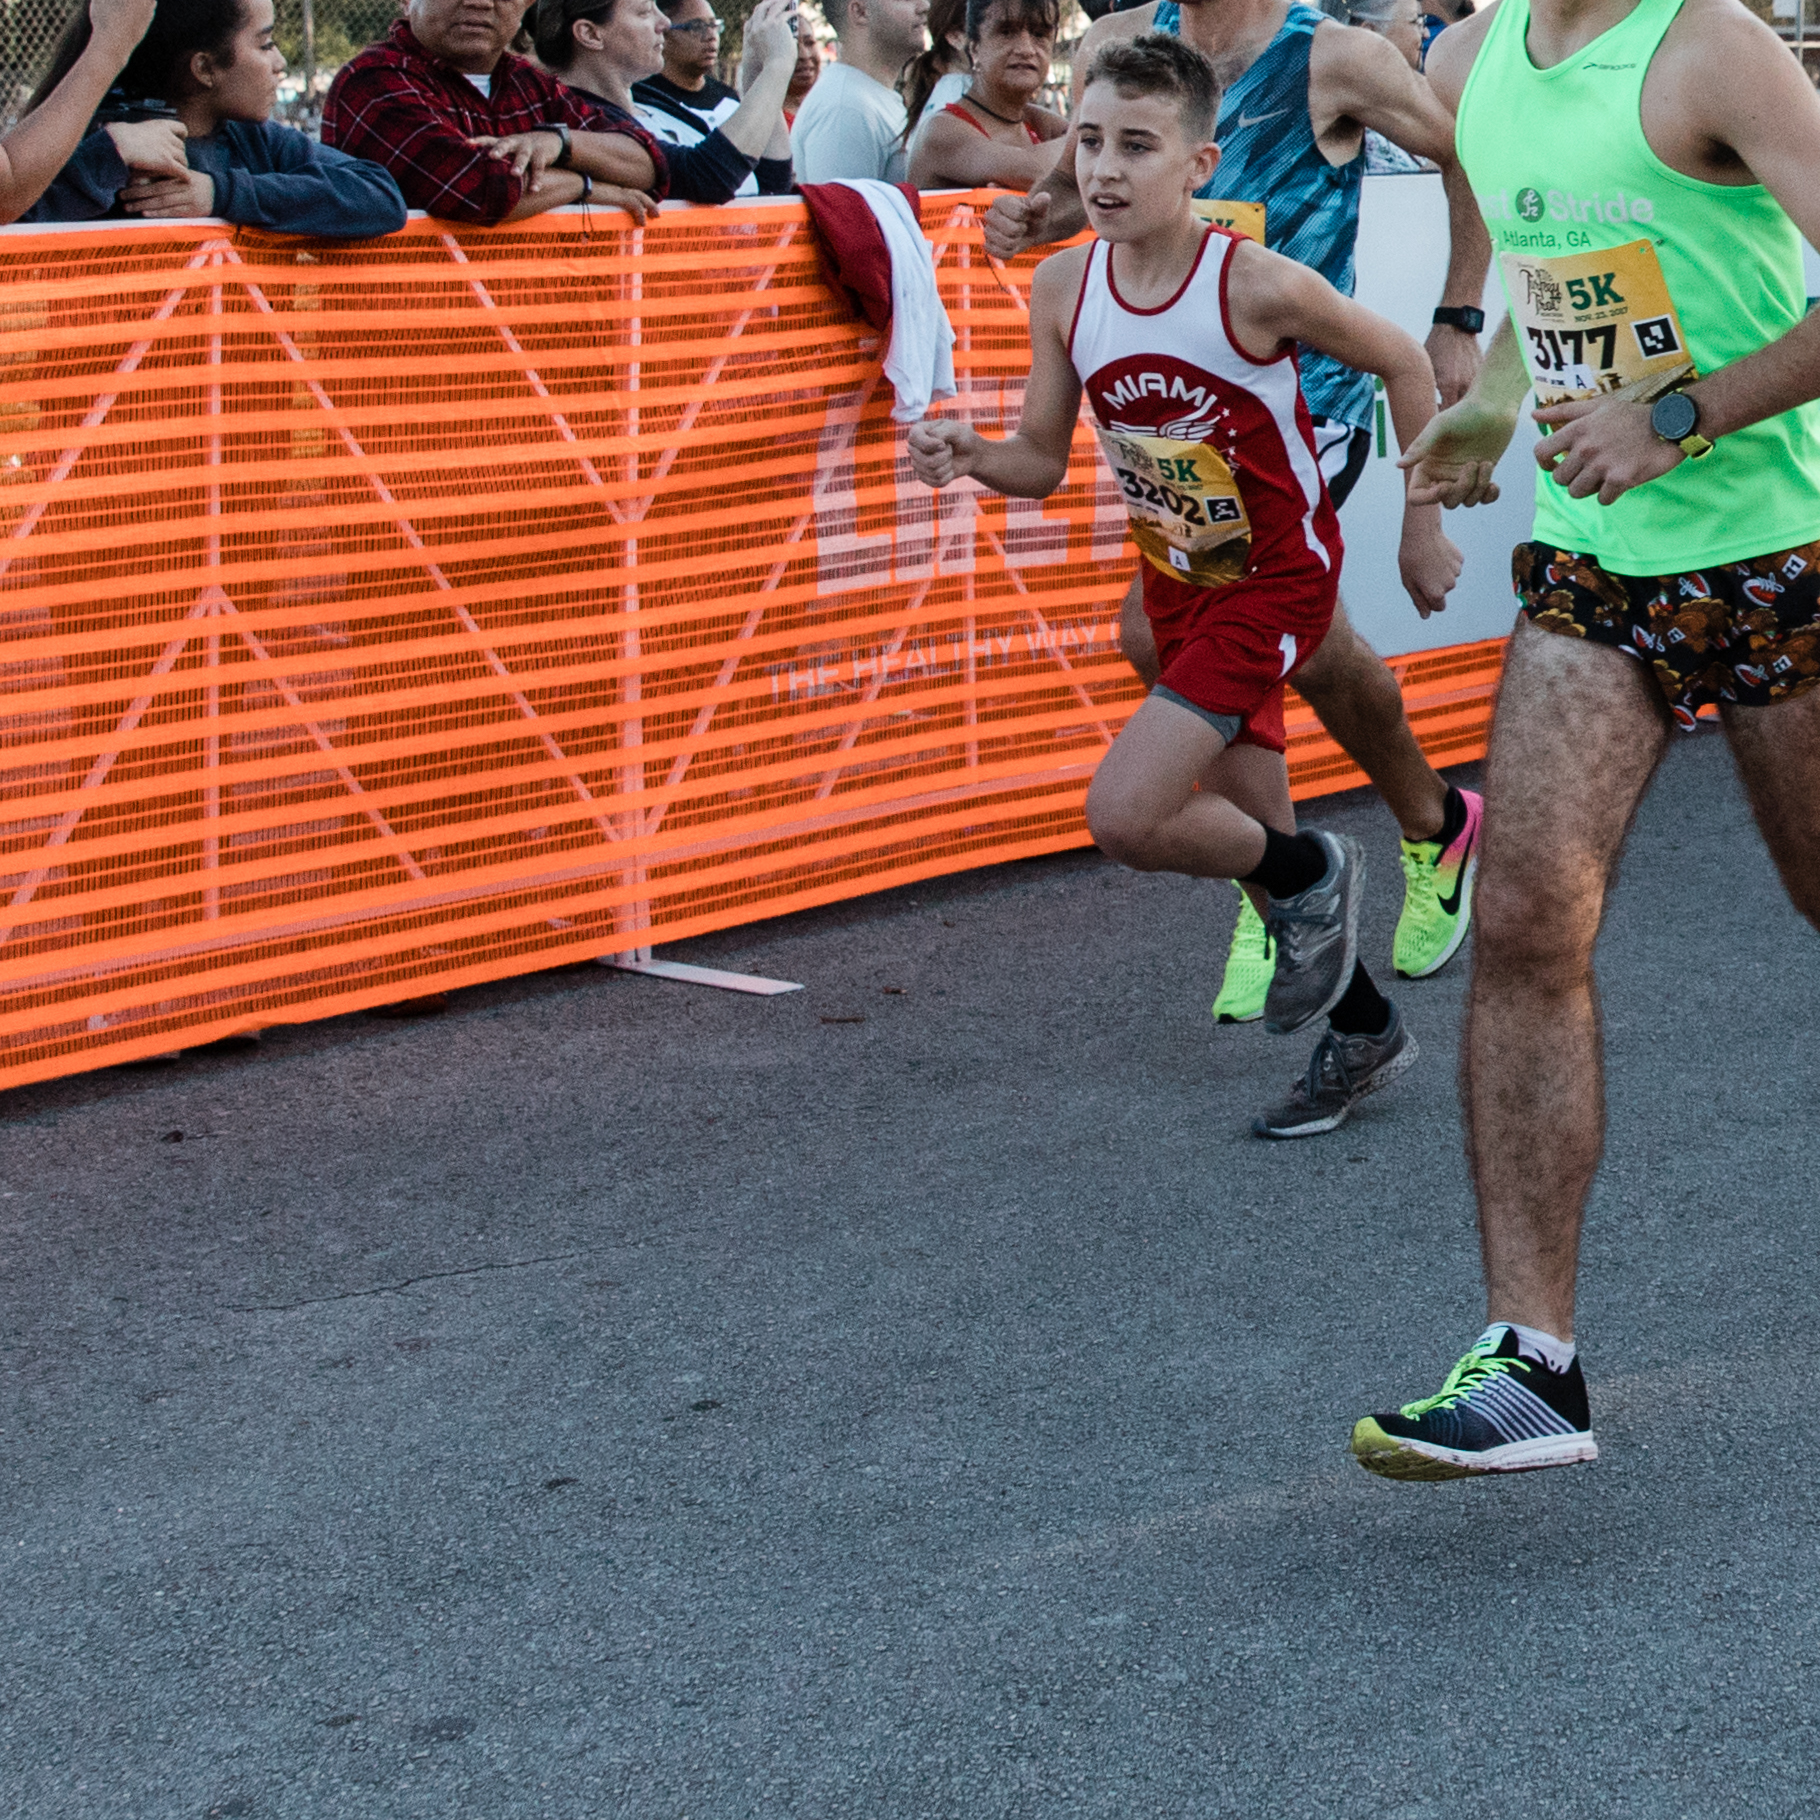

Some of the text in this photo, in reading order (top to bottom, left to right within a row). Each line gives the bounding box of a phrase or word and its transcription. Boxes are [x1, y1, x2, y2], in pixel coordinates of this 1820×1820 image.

[1547, 189, 1654, 224] Stride
[1503, 231, 1592, 249] Atlanta, GA
[1565, 272, 1625, 310] 5K
[1526, 324, 1618, 371] 3177
[1102, 372, 1218, 425] MIAMI
[1576, 374, 1587, 389] A
[1157, 457, 1202, 483] 5K
[1116, 467, 1206, 526] 3202
[1175, 554, 1183, 566] A
[764, 654, 839, 704] THE
[852, 624, 1014, 690] HEALTHY
[1025, 616, 1099, 661] WAY
